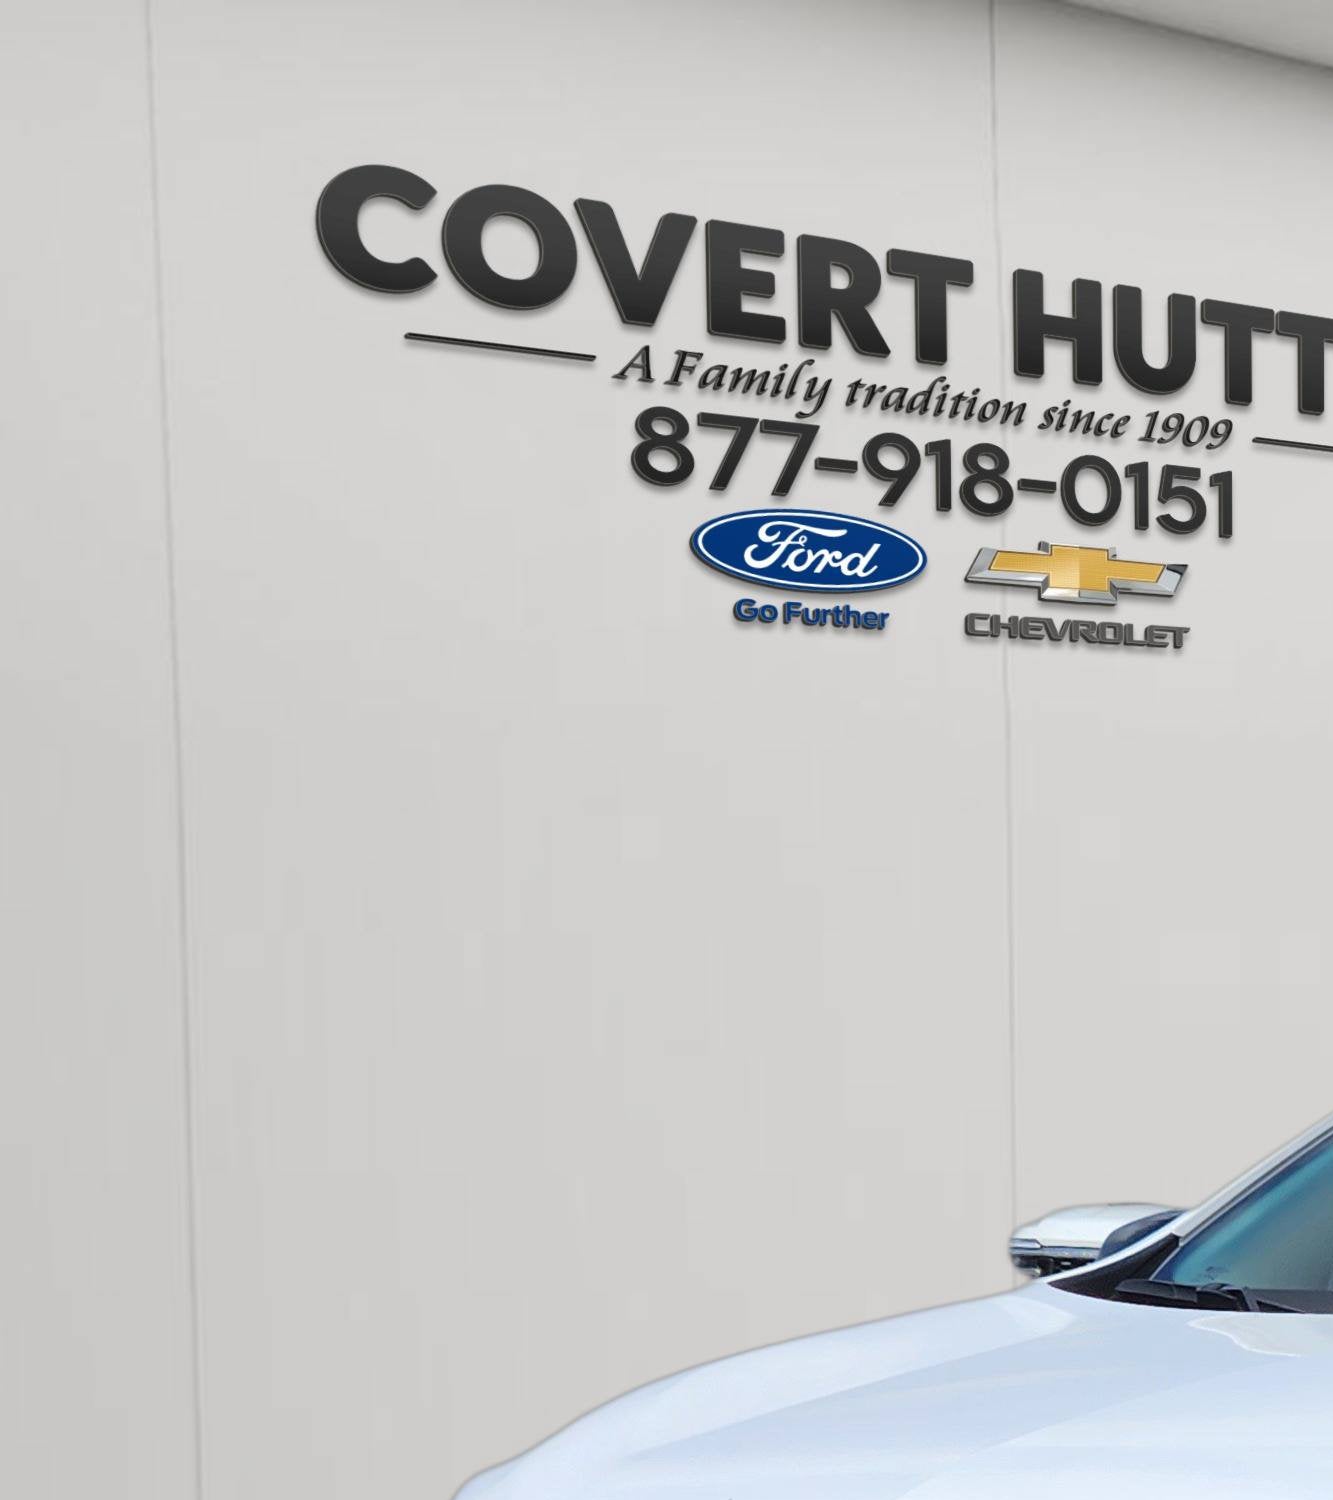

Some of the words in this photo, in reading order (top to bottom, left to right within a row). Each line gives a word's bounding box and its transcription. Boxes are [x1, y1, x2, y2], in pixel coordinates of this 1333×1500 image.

[315, 163, 974, 366] COVERT
[612, 345, 655, 383] A
[664, 350, 833, 419] Family
[845, 376, 1027, 427] tradition
[1037, 400, 1131, 439] since
[1138, 410, 1233, 450] 1909
[630, 405, 1233, 539] 877-918-0151
[743, 520, 881, 578] Ford
[732, 597, 778, 625] Go
[782, 601, 890, 631] Further
[963, 611, 1191, 650] CHEVROLET
